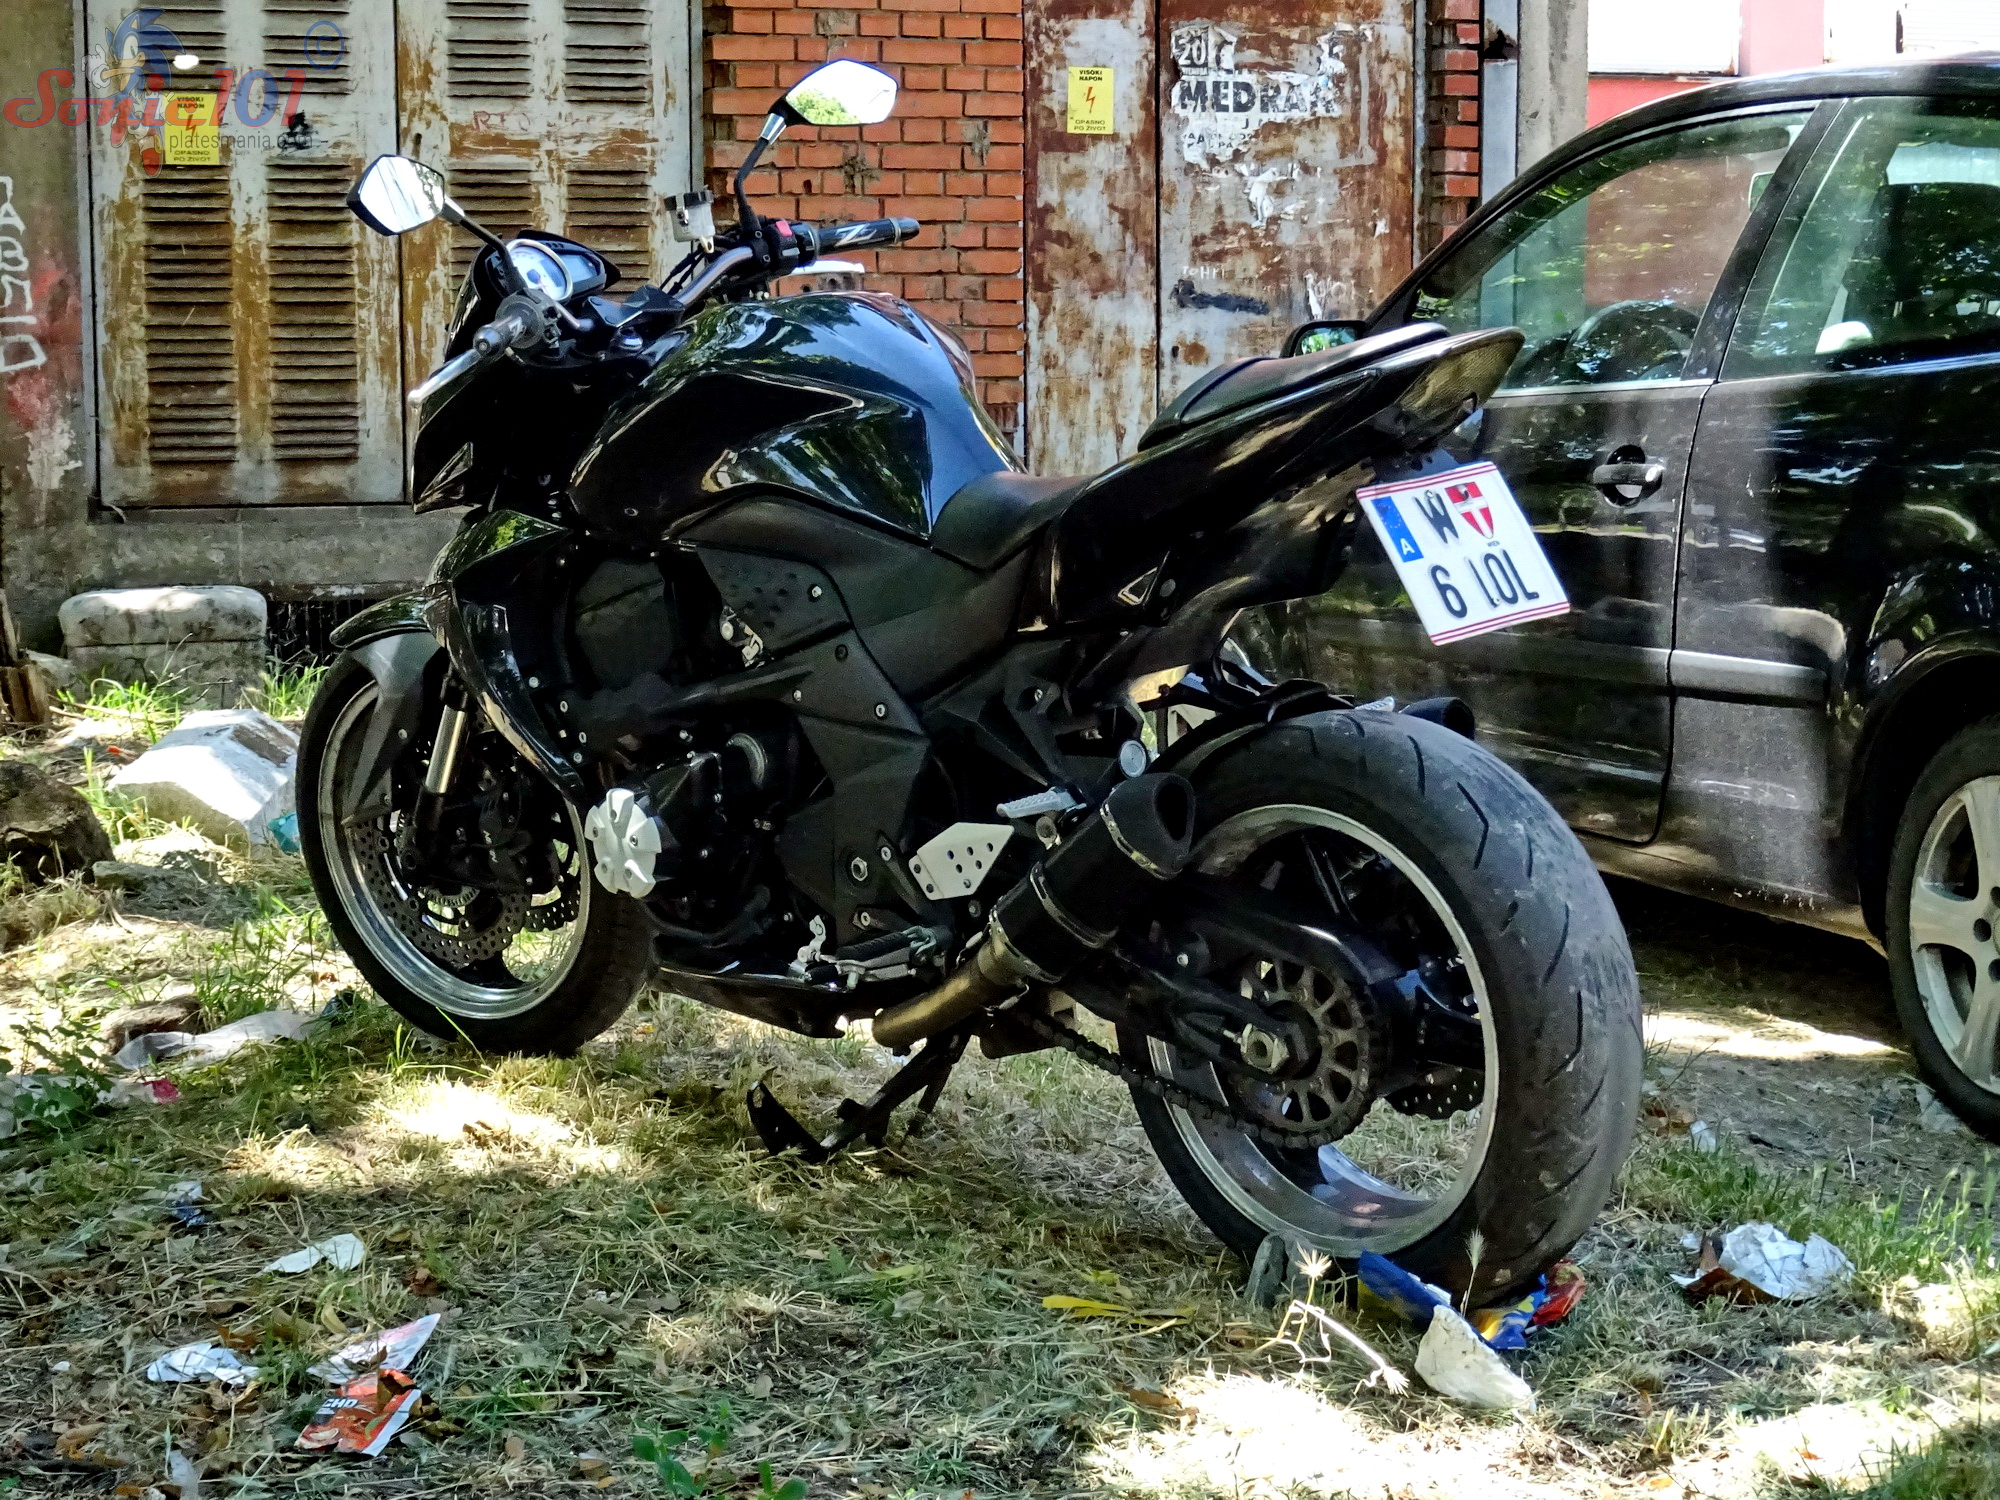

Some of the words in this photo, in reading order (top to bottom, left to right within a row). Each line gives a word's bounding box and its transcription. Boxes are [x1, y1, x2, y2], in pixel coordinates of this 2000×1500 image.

[1413, 491, 1459, 544] W
[1400, 538, 1415, 555] A
[1430, 564, 1468, 619] 6
[1467, 549, 1540, 608] LOL
